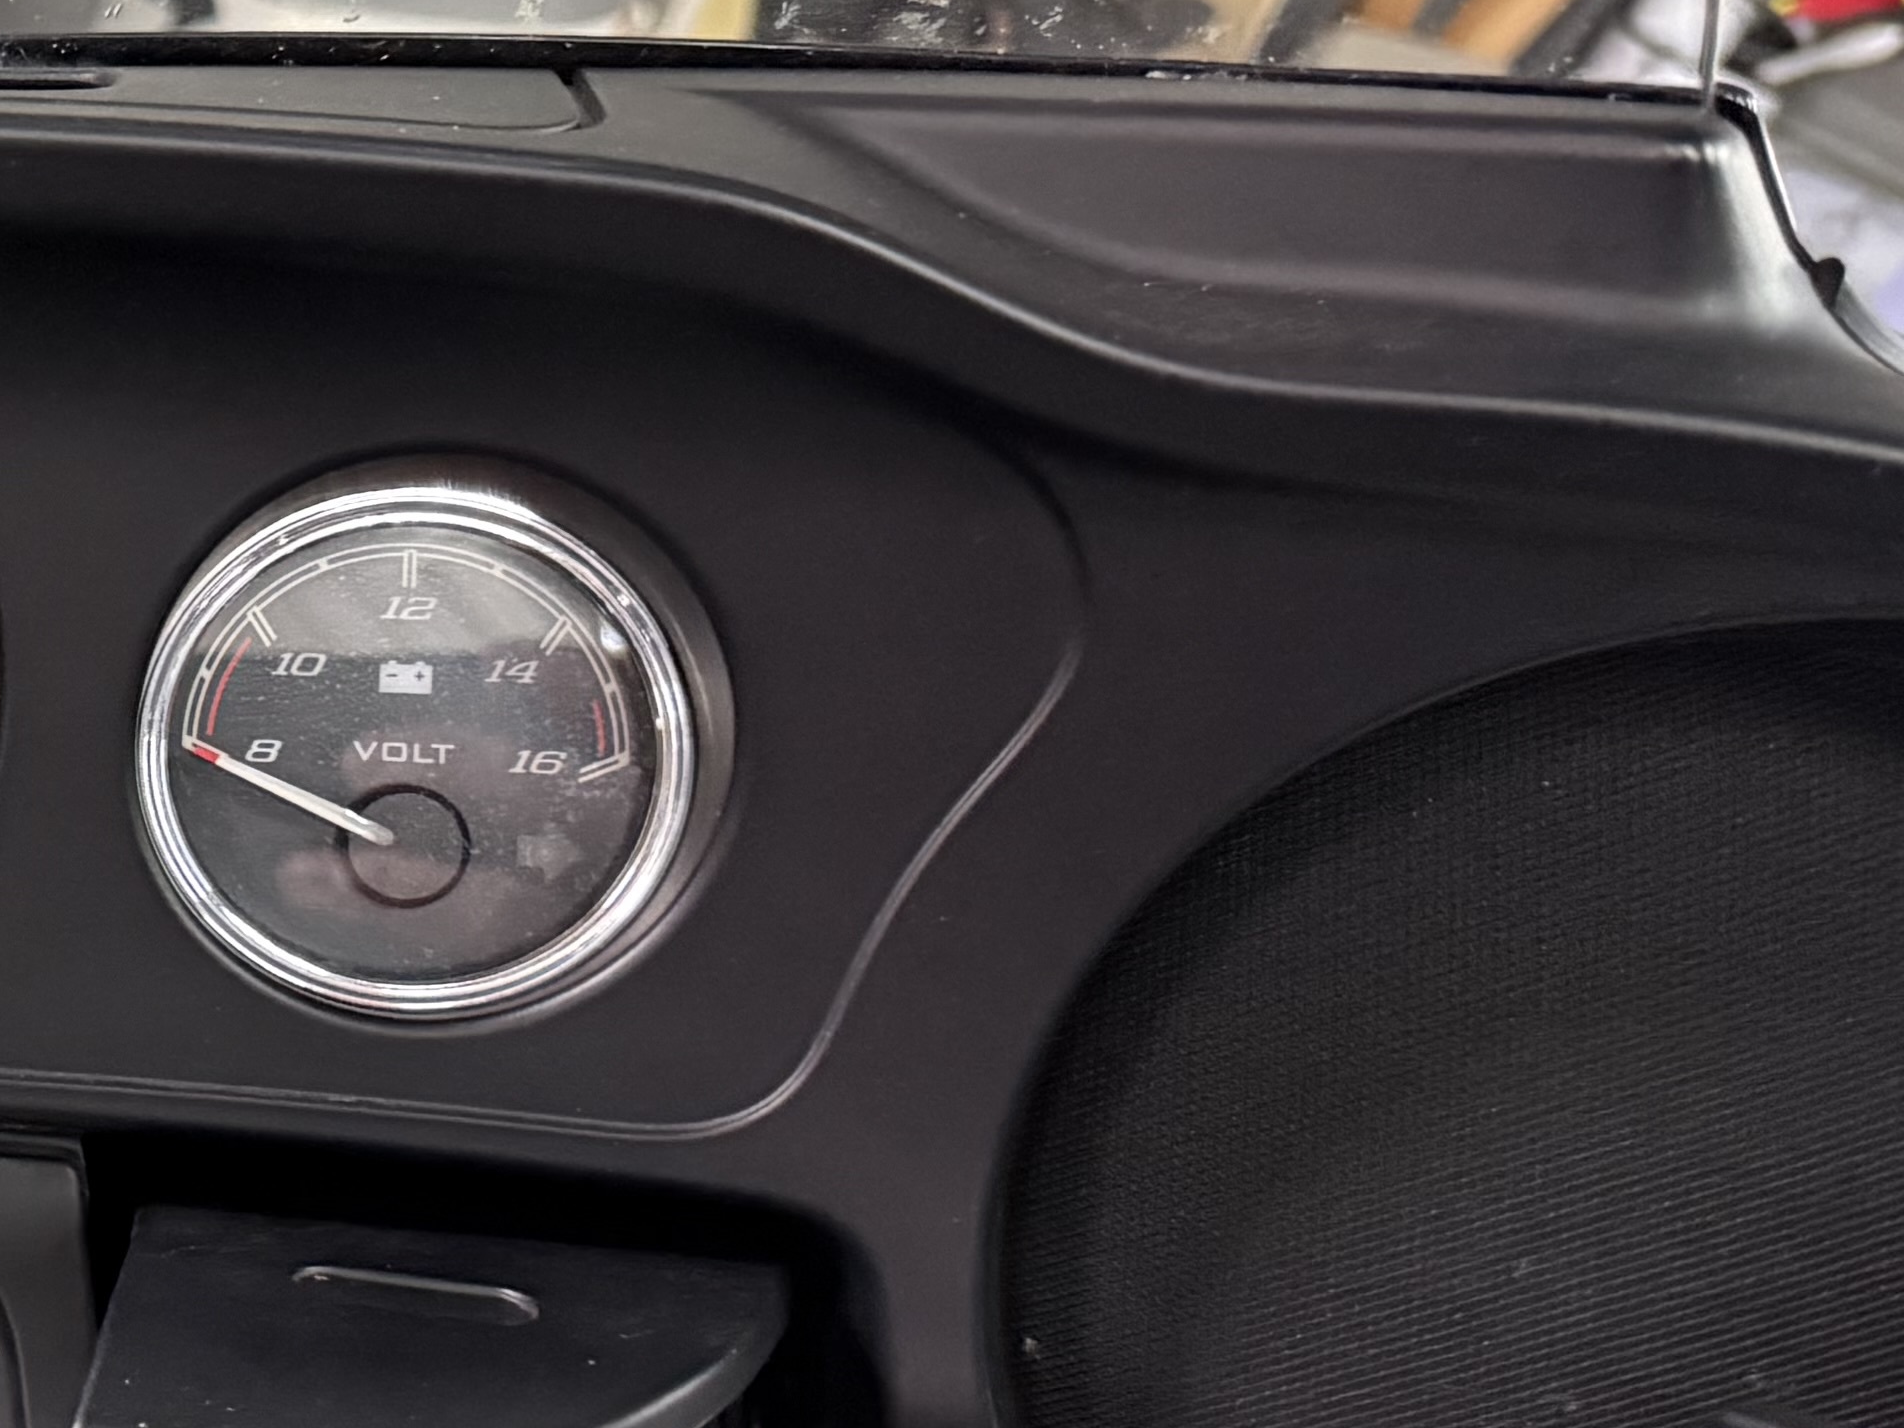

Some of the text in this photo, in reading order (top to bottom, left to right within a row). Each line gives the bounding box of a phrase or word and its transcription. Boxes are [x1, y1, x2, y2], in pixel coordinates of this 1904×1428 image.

[381, 597, 436, 620] 12
[271, 654, 327, 676] 10
[484, 660, 539, 683] 14
[245, 739, 282, 762] 8
[354, 741, 454, 765] VOLT
[509, 751, 567, 774] 16
